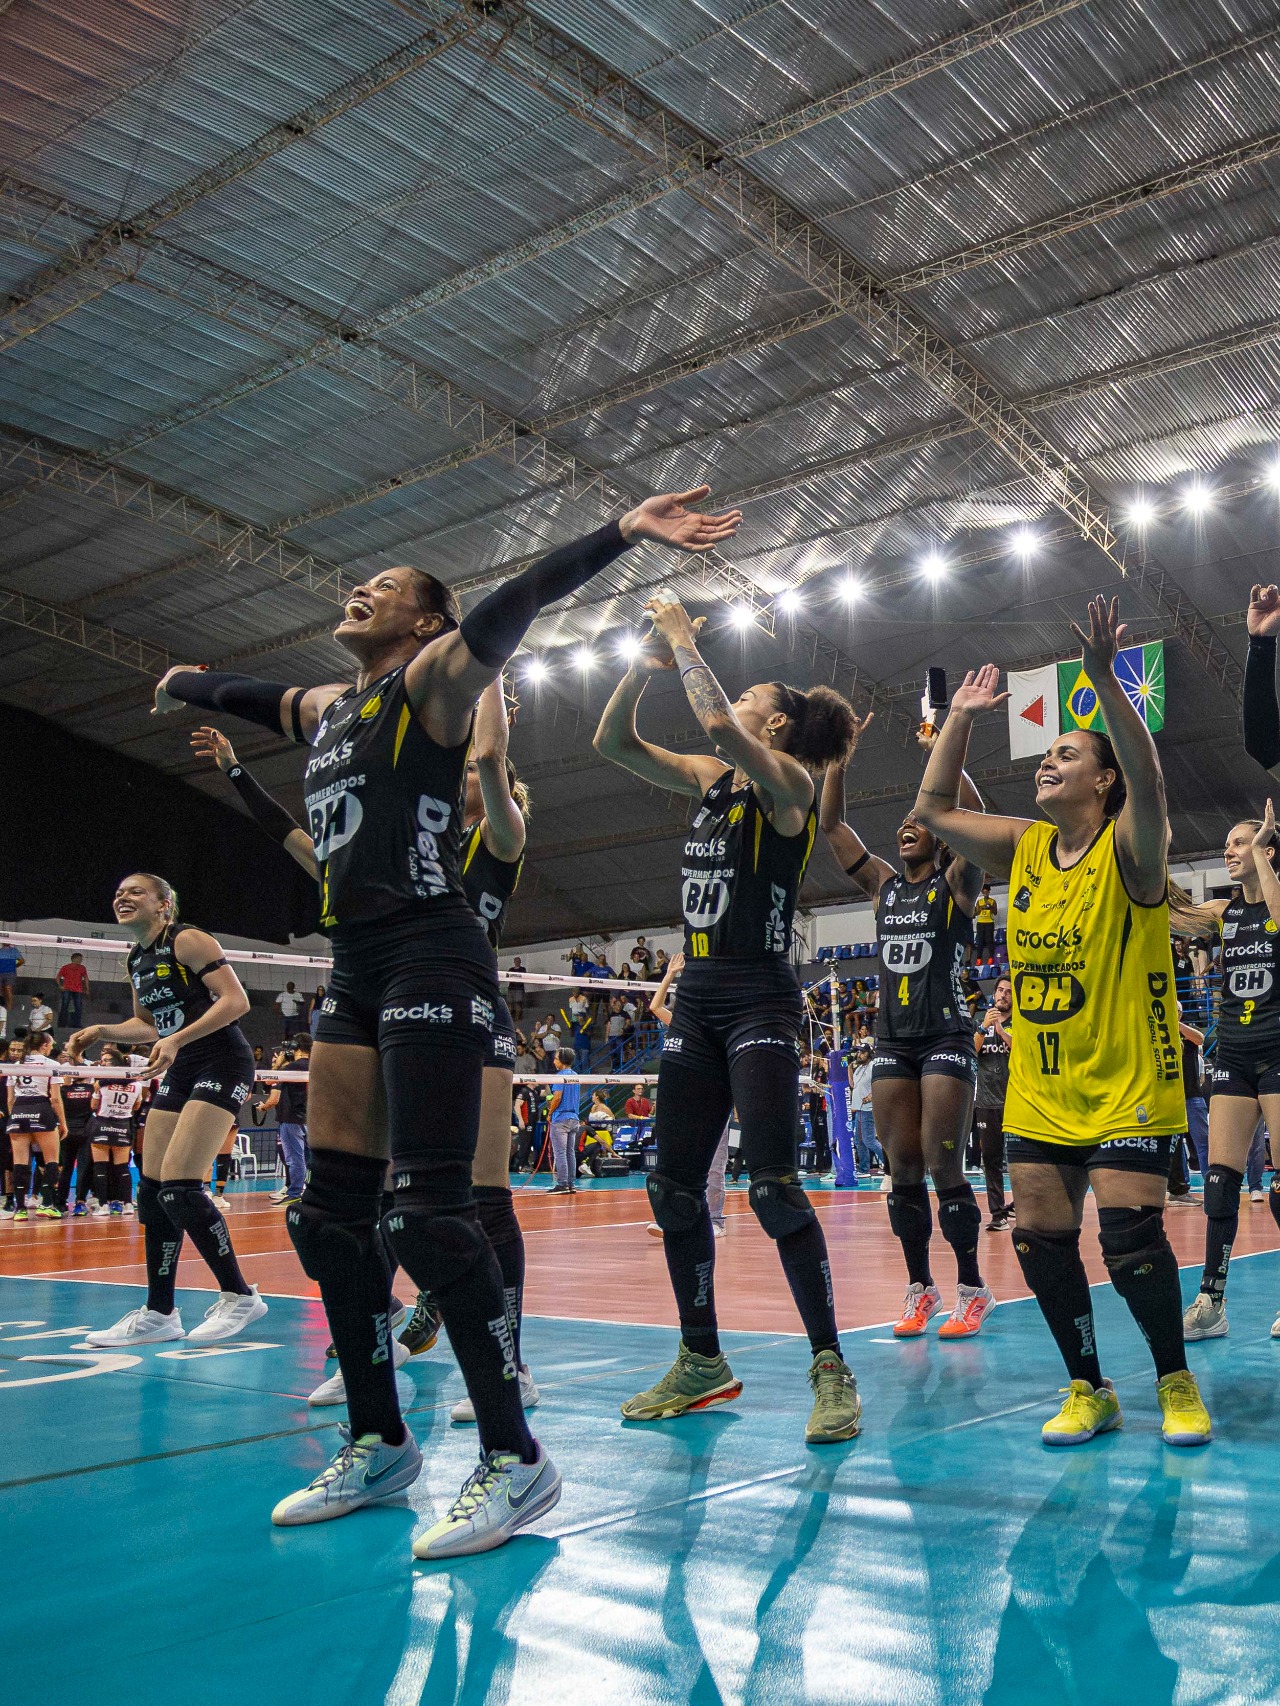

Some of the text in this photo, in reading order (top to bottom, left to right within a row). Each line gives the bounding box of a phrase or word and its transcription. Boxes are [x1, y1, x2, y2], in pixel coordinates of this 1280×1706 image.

[311, 795, 347, 849] BH
[685, 882, 721, 914] BH
[884, 911, 928, 926] crock's
[880, 931, 936, 941] SUPERMERCADOS
[1016, 924, 1082, 949] crock's
[888, 942, 924, 965] BH
[1225, 941, 1273, 958] crock's
[1011, 960, 1086, 973] SUPERMERCADOS
[898, 976, 910, 1006] 4
[1020, 976, 1072, 1011] BH
[1235, 971, 1265, 992] BH
[382, 1003, 453, 1022] crock's
[1239, 1000, 1256, 1025] 3
[1147, 971, 1181, 1082] Dentil
[931, 1053, 967, 1065] crock's
[1036, 1031, 1061, 1076] 17
[110, 1085, 135, 1093] SESI
[113, 1092, 129, 1105] 10
[100, 1126, 128, 1134] Unimed
[158, 1242, 177, 1276] Dentil
[1218, 1244, 1233, 1274] Dentil
[1074, 1313, 1095, 1357] Dentil
